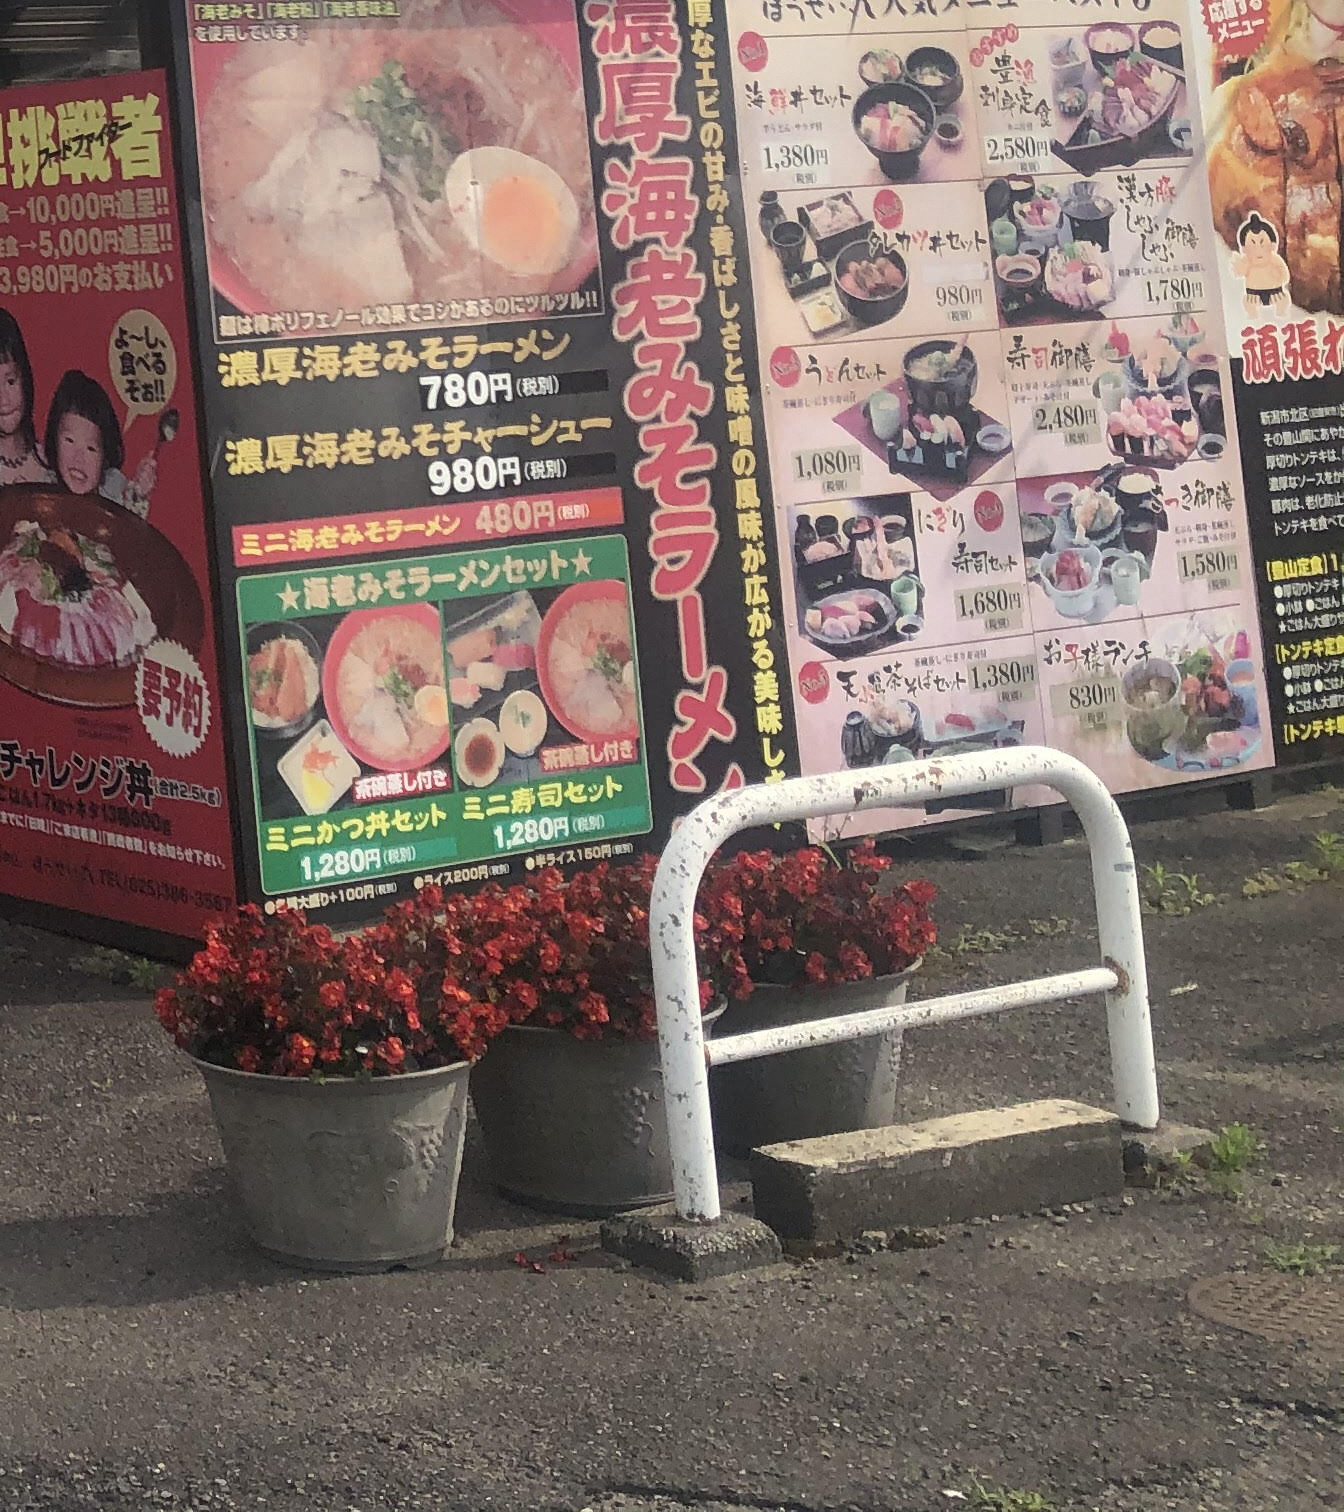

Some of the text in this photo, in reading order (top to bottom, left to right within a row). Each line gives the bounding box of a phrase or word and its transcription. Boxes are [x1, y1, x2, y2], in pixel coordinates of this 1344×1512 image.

[1218, 18, 1265, 44] メニュー
[762, 142, 830, 171] 1,380円
[986, 135, 1050, 162] 2,580円
[935, 284, 983, 308] 980円
[1146, 278, 1206, 303] 1,780円
[118, 351, 167, 377] 食べる
[217, 328, 572, 389] 濃厚海老みそラーメン
[1035, 404, 1097, 432] 2,480円
[224, 412, 613, 477] 濃厚海老みそチャーシュー
[795, 450, 862, 479] 1,080円
[1266, 448, 1344, 471] 厚切りトンテキは、
[239, 514, 462, 558] ミニ海老みそラーメン
[1181, 551, 1239, 579] 1,580円
[958, 588, 1023, 619] 1,680円
[971, 660, 1035, 691] 1,380円
[141, 656, 204, 738] 要予約
[1068, 684, 1117, 711] 830円
[461, 775, 624, 822] ミニ寿司セット
[264, 804, 449, 853] ミニかつ丼セット
